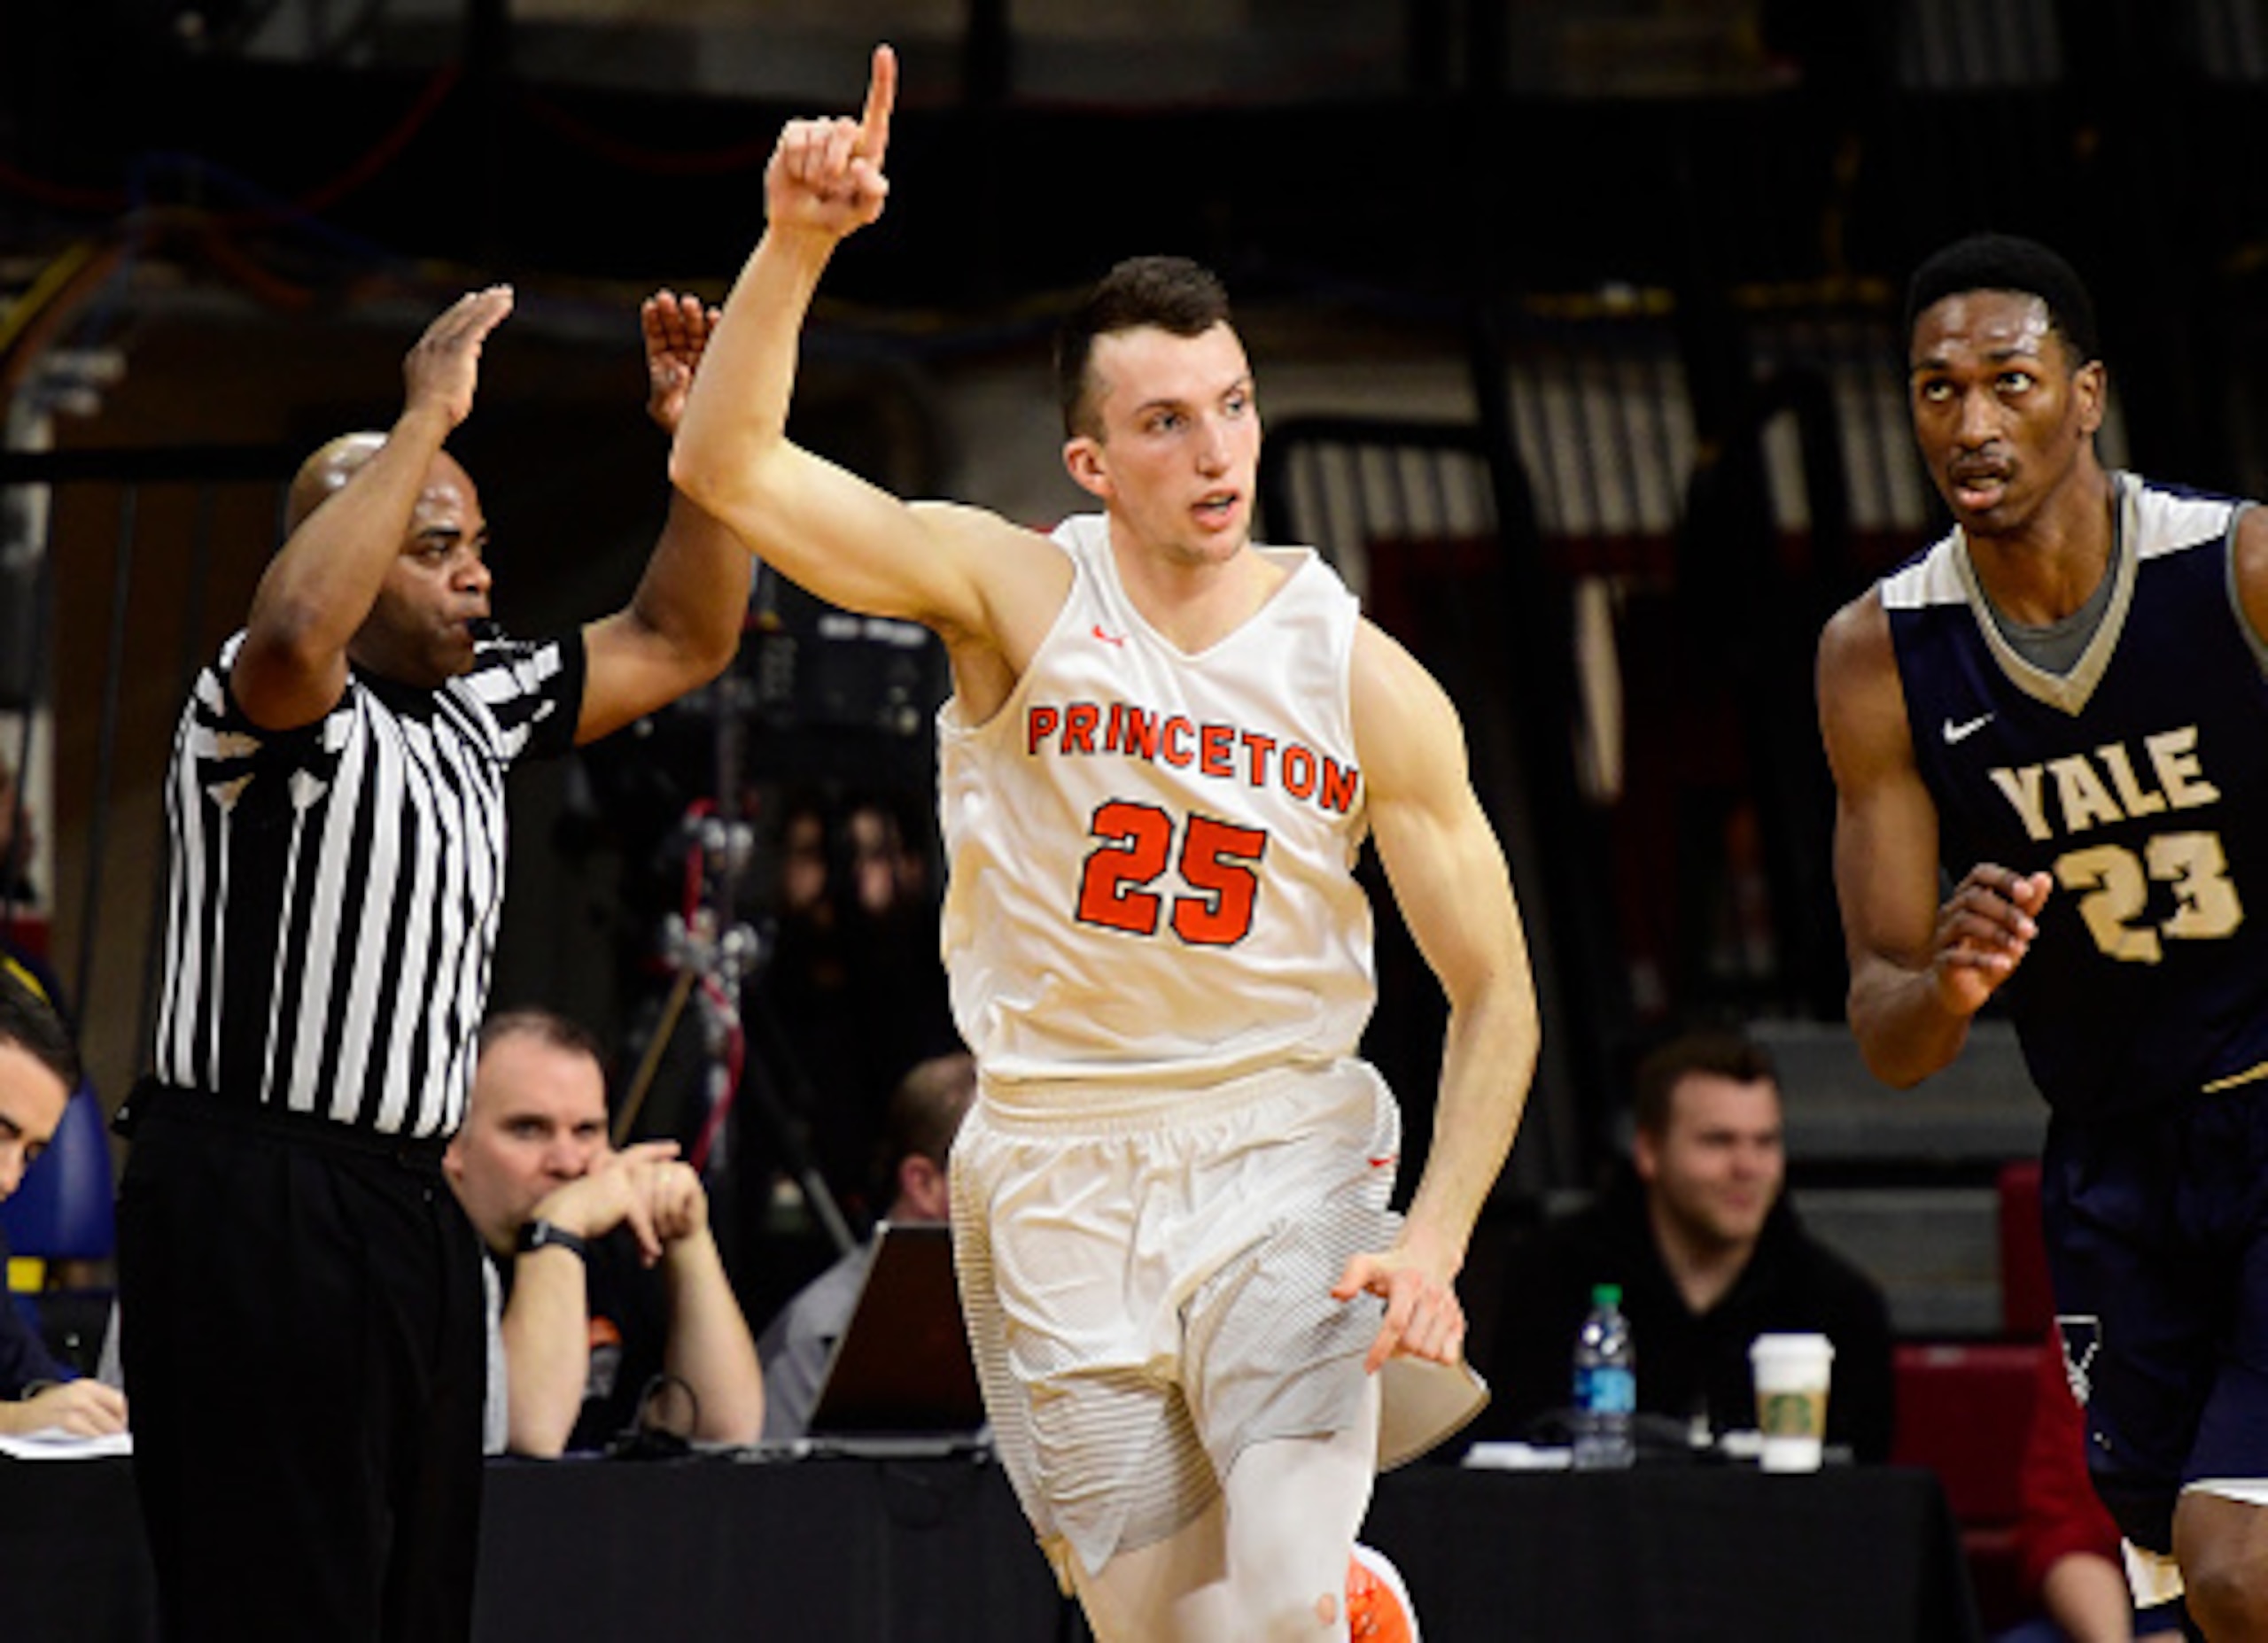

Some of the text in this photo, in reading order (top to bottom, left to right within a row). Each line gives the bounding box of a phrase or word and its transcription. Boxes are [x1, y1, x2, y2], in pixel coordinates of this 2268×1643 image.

[1028, 702, 1359, 814] PRINCETON
[1989, 724, 2222, 841] YALE
[1075, 797, 1268, 947] 25
[2052, 831, 2244, 965] 23
